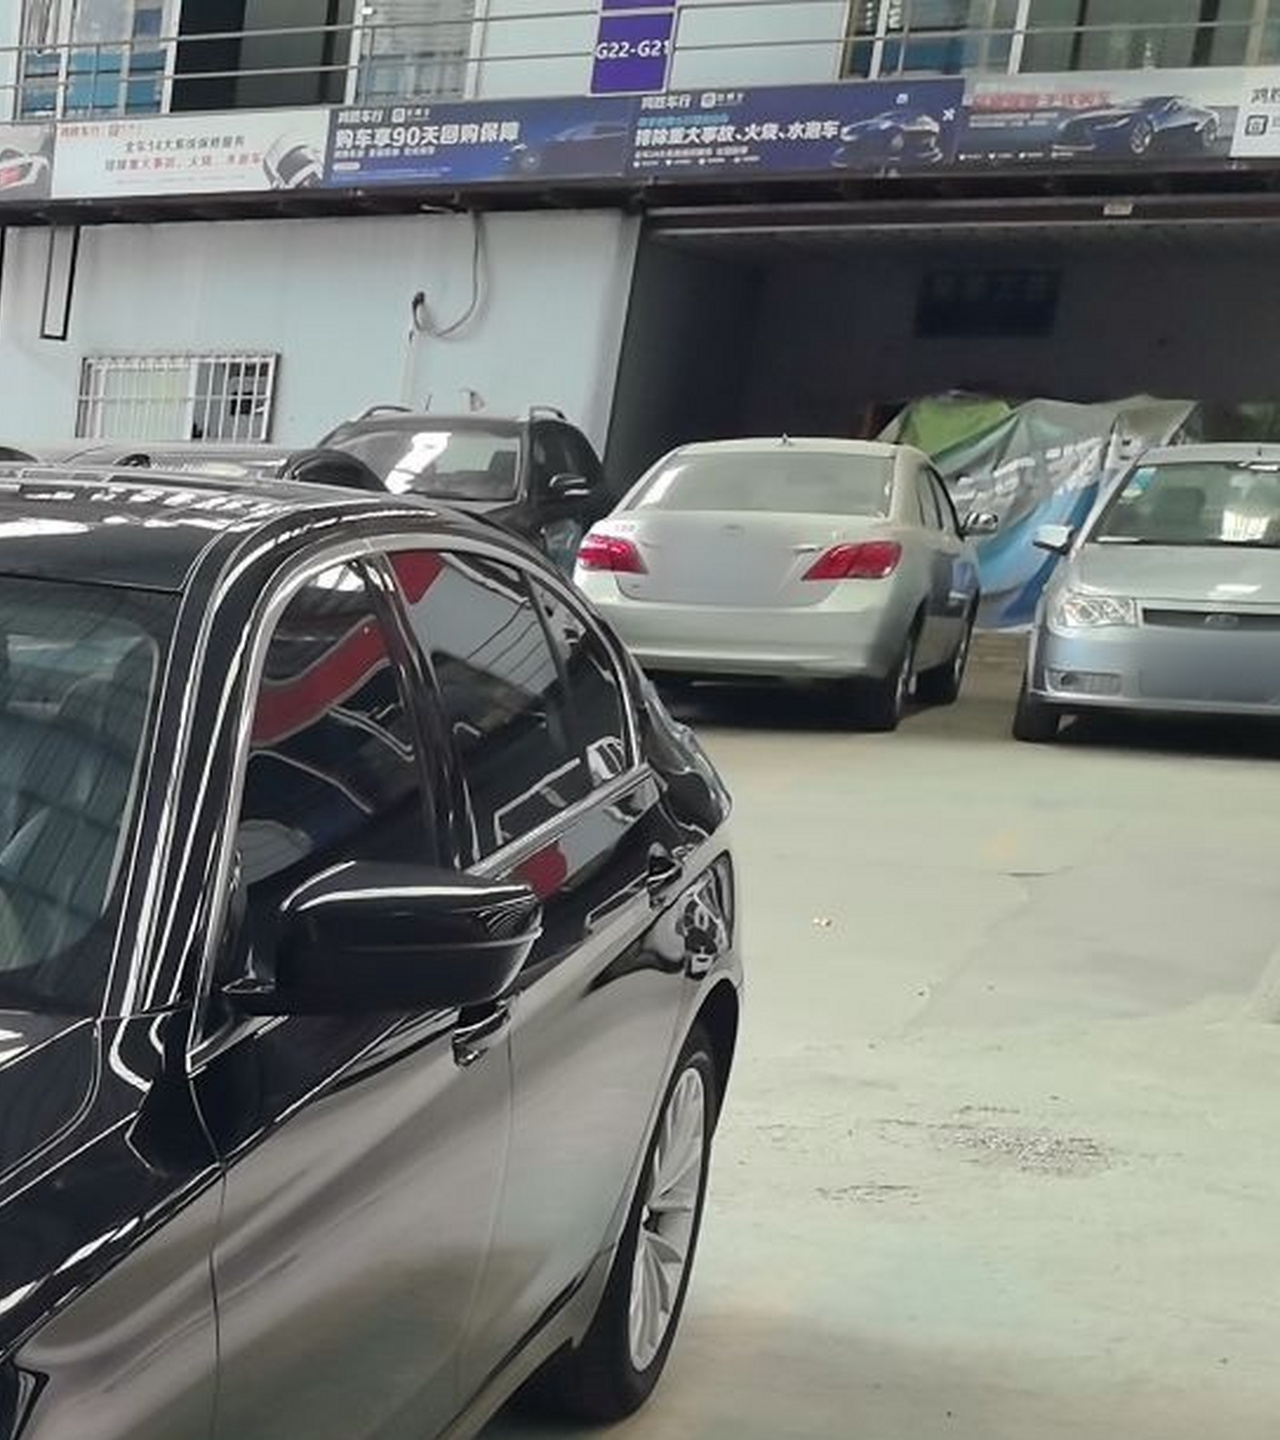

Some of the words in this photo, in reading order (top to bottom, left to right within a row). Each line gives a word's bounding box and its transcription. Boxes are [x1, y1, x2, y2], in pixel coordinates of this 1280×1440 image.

[335, 121, 520, 149] 购车享90天回购保障
